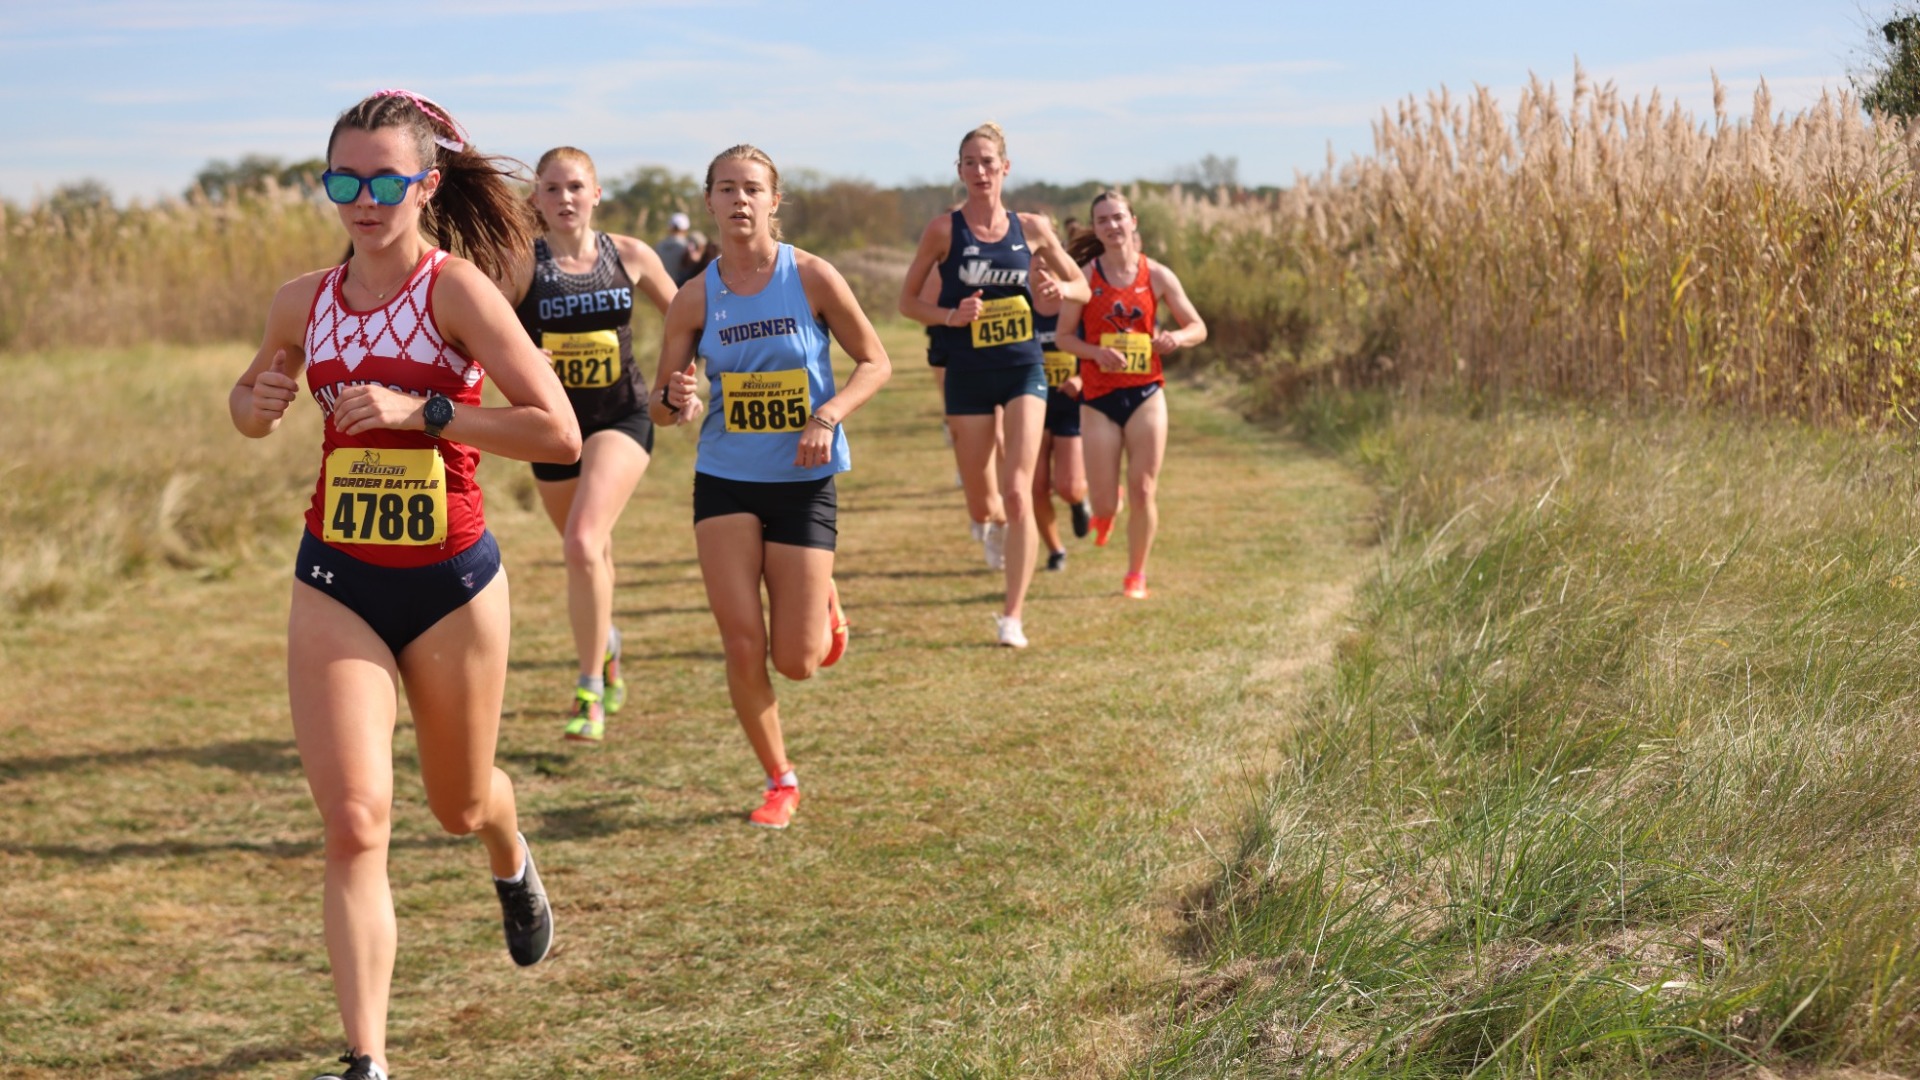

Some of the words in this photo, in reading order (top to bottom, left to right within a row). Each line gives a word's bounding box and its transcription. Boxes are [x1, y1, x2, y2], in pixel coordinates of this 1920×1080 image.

[539, 287, 632, 320] OSPREYS
[719, 317, 798, 346] WIDENER
[978, 317, 1027, 343] 4541
[554, 357, 612, 385] 4821
[767, 387, 804, 398] BATTLE
[729, 397, 807, 430] 4885
[350, 461, 407, 475] Rowan
[332, 477, 383, 489] BORDER
[384, 479, 439, 490] BATTLE
[332, 492, 435, 541] 4788
